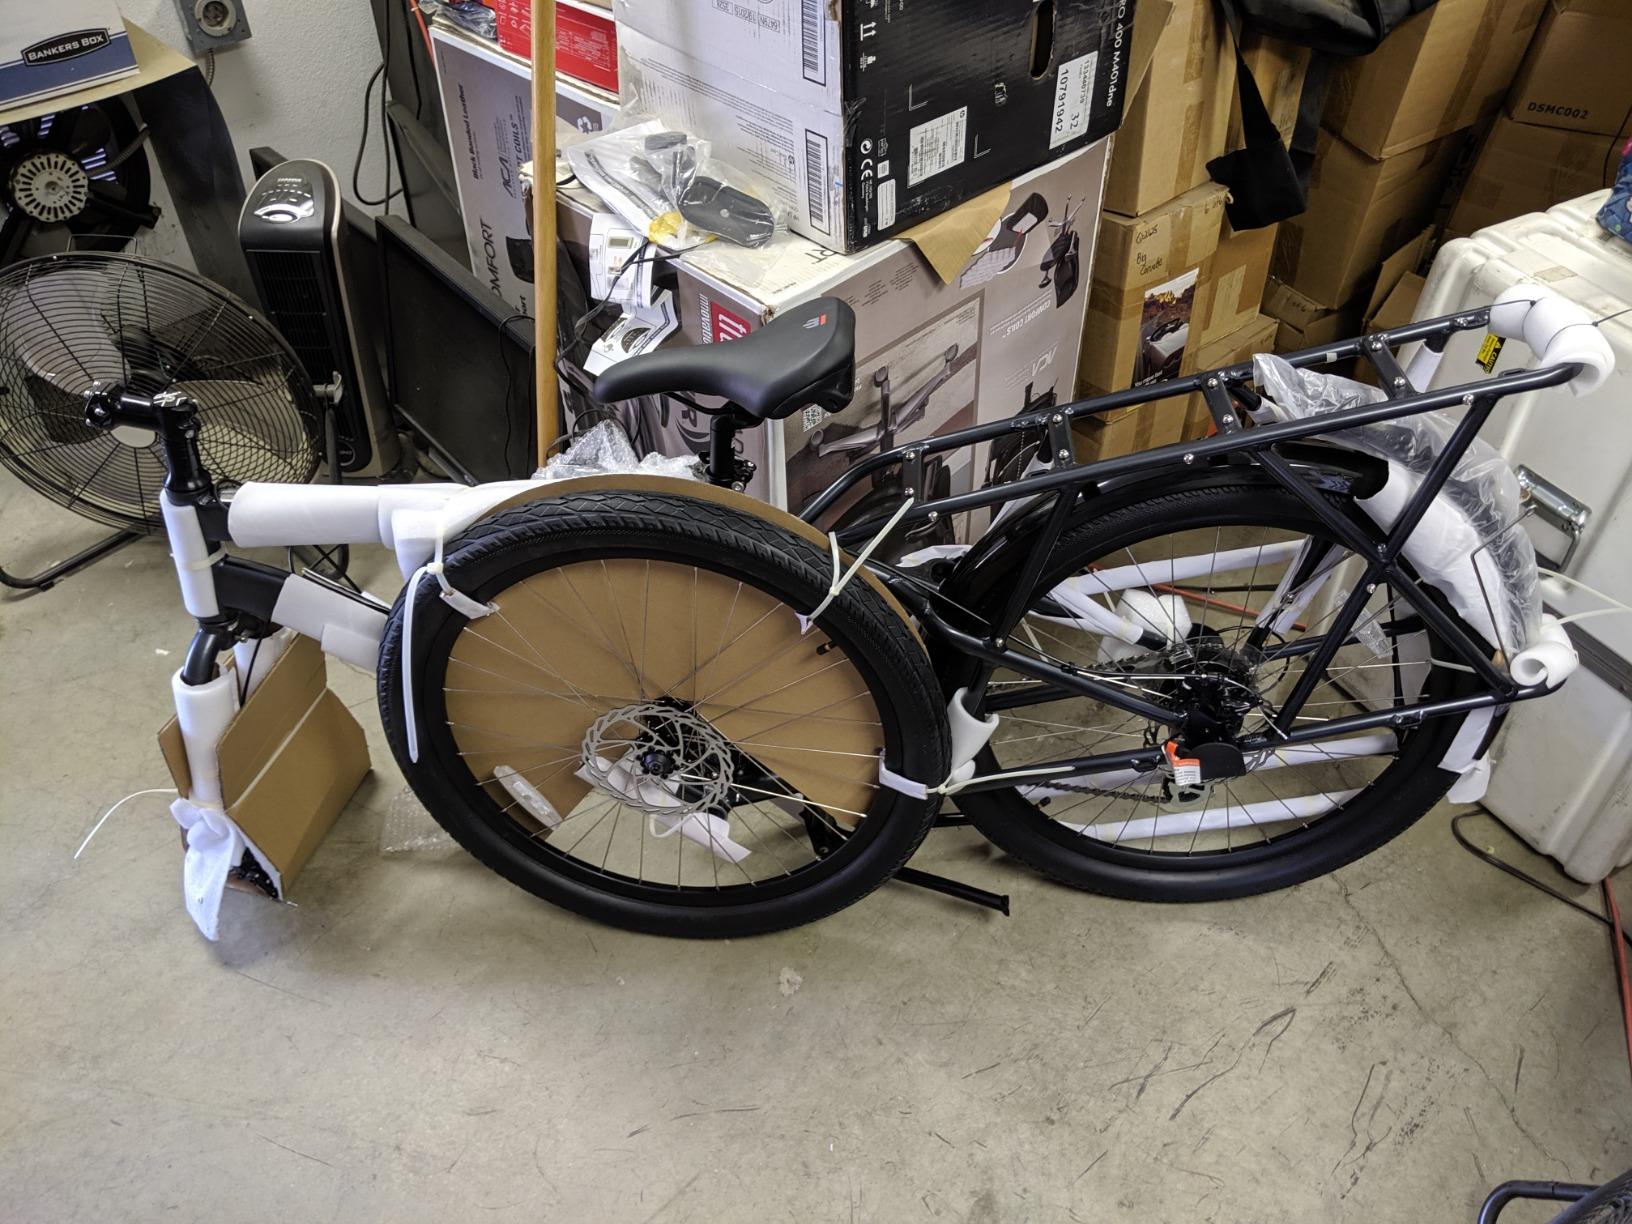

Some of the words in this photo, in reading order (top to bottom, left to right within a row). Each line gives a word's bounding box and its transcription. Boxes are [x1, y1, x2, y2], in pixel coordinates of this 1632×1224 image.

[1116, 0, 1127, 19] RO
[28, 40, 80, 62] BANKERS
[81, 34, 104, 47] BOX
[1113, 22, 1124, 48] 400
[1106, 50, 1121, 108] M401dne
[459, 84, 470, 118] Leather
[1054, 68, 1069, 133] 10791942
[1527, 101, 1590, 120] DSMC002
[1069, 111, 1080, 131] 32
[466, 120, 476, 152] Bonded
[472, 151, 480, 180] Black
[479, 219, 503, 297] OMFORT
[698, 293, 713, 345] innovatio
[1025, 299, 1051, 324] COMFORT
[1005, 318, 1025, 336] COILS
